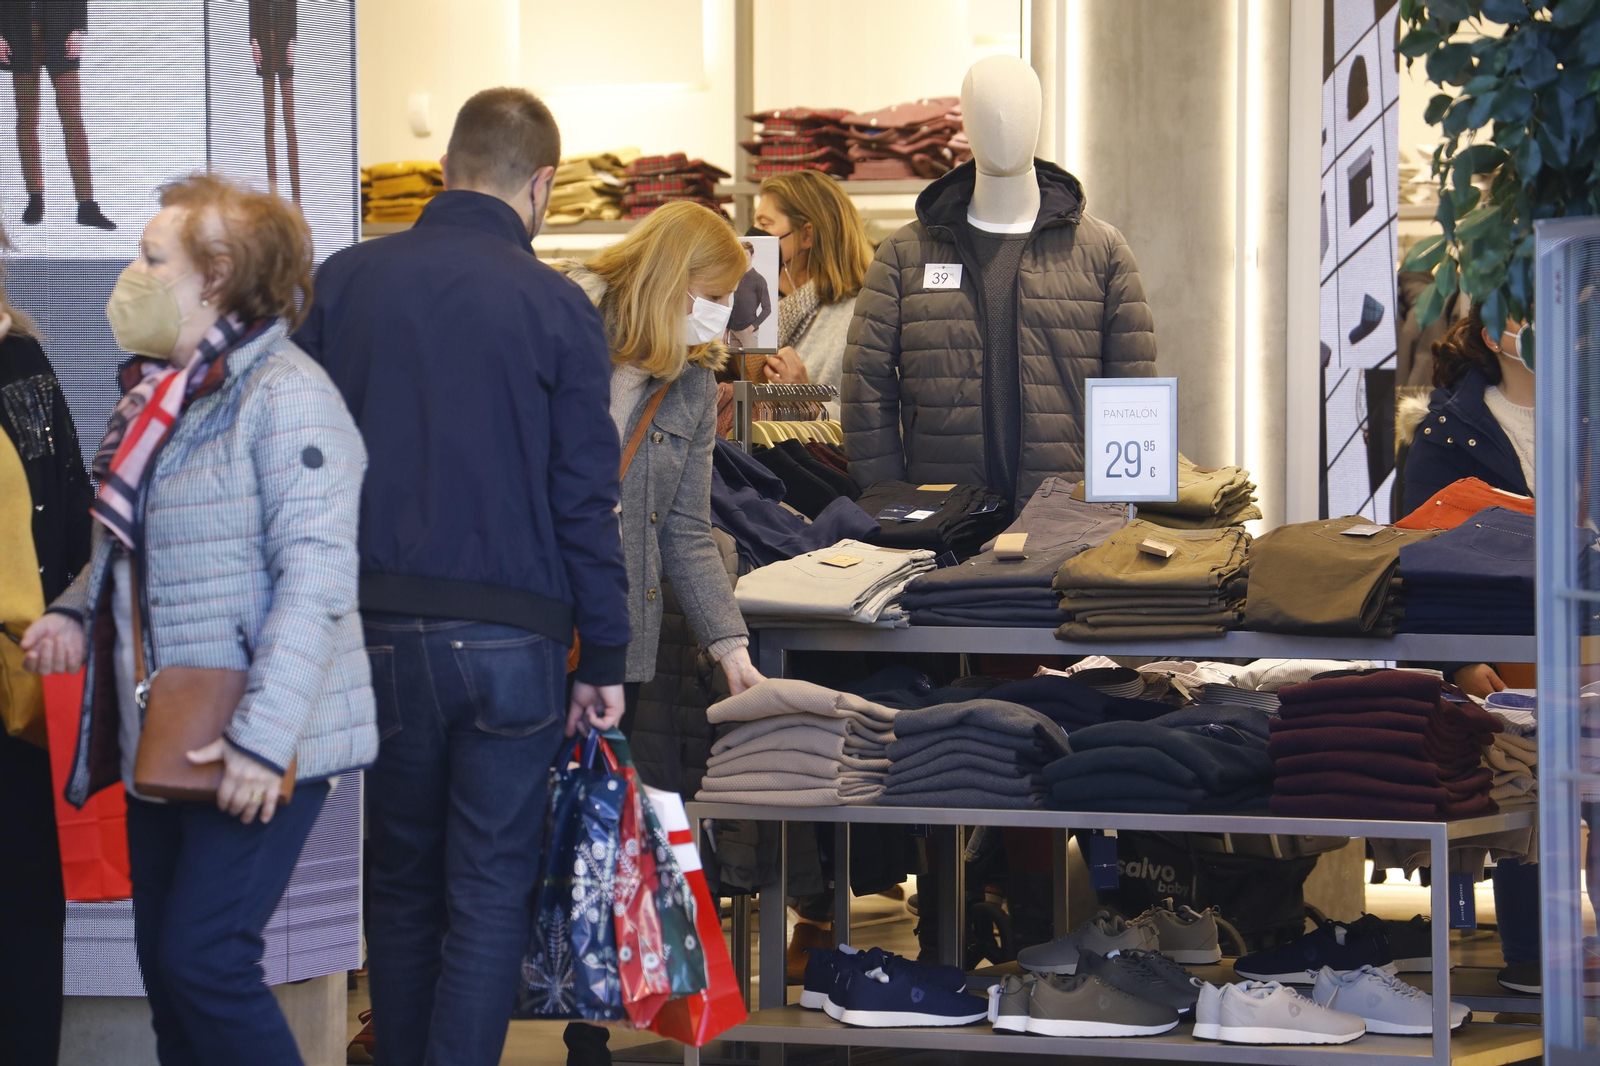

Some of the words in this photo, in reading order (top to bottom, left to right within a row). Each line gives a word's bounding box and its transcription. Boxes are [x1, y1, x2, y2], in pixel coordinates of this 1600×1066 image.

[931, 271, 949, 285] 39
[1103, 406, 1158, 419] PANTALÓN
[1105, 440, 1142, 479] 29
[1143, 440, 1156, 452] 95
[1149, 466, 1156, 478] €
[1117, 856, 1176, 882] salvo
[1157, 880, 1190, 897] baby
